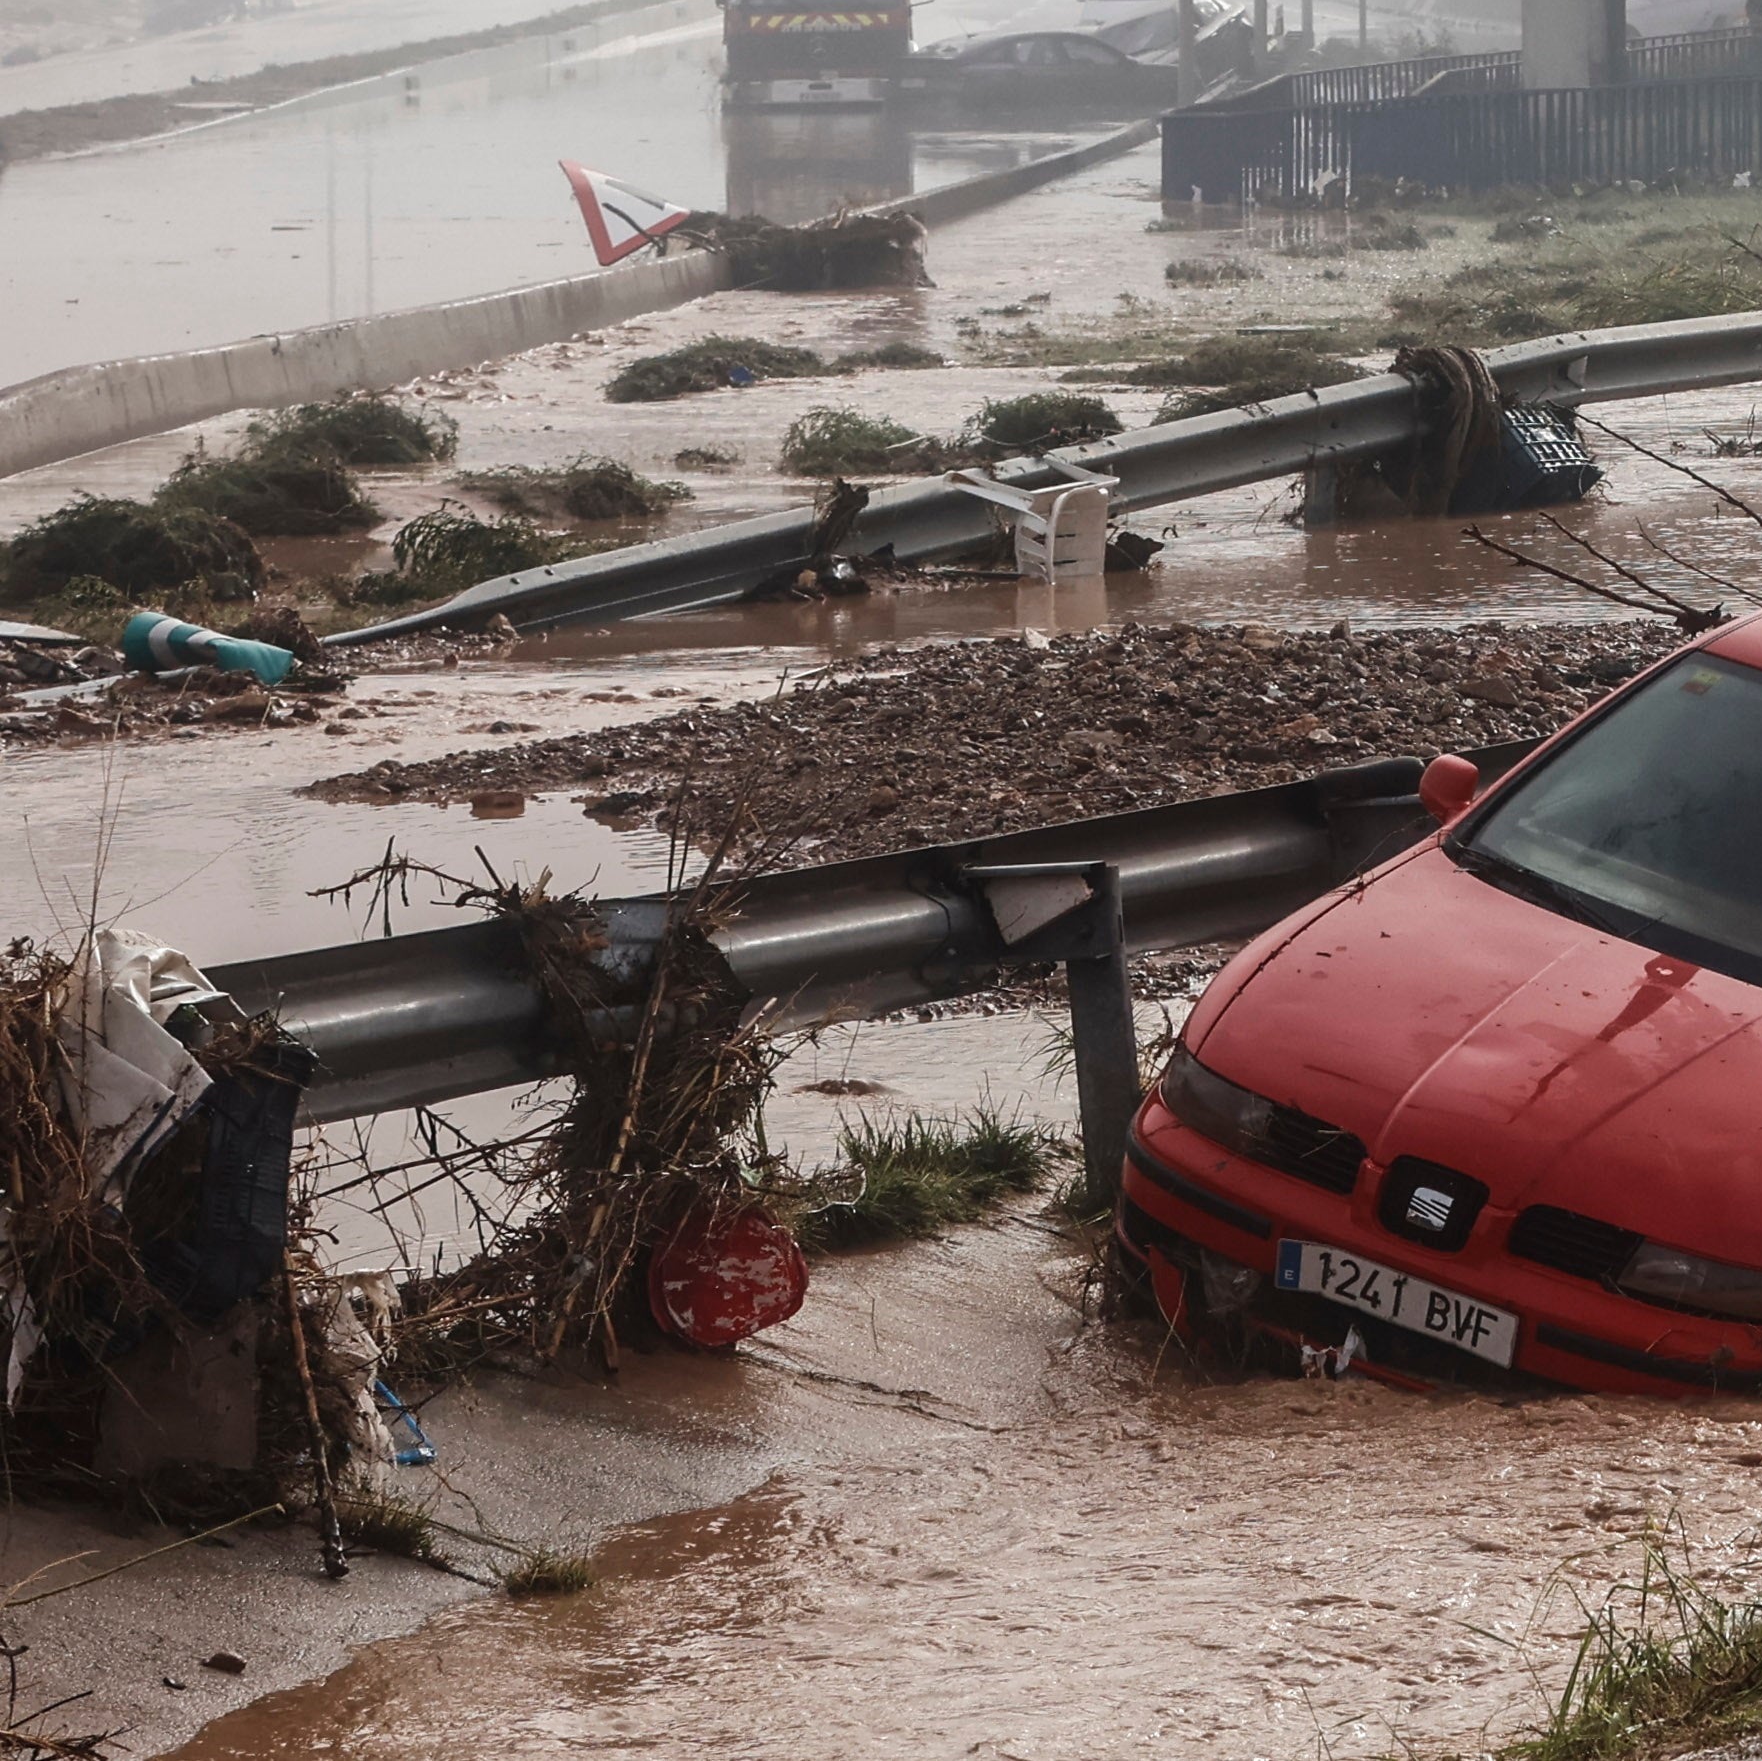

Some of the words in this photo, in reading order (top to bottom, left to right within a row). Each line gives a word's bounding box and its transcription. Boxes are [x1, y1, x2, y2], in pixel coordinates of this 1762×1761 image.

[1284, 1269, 1294, 1281] E
[1319, 1252, 1408, 1317] 1241
[1424, 1290, 1499, 1348] BVF
